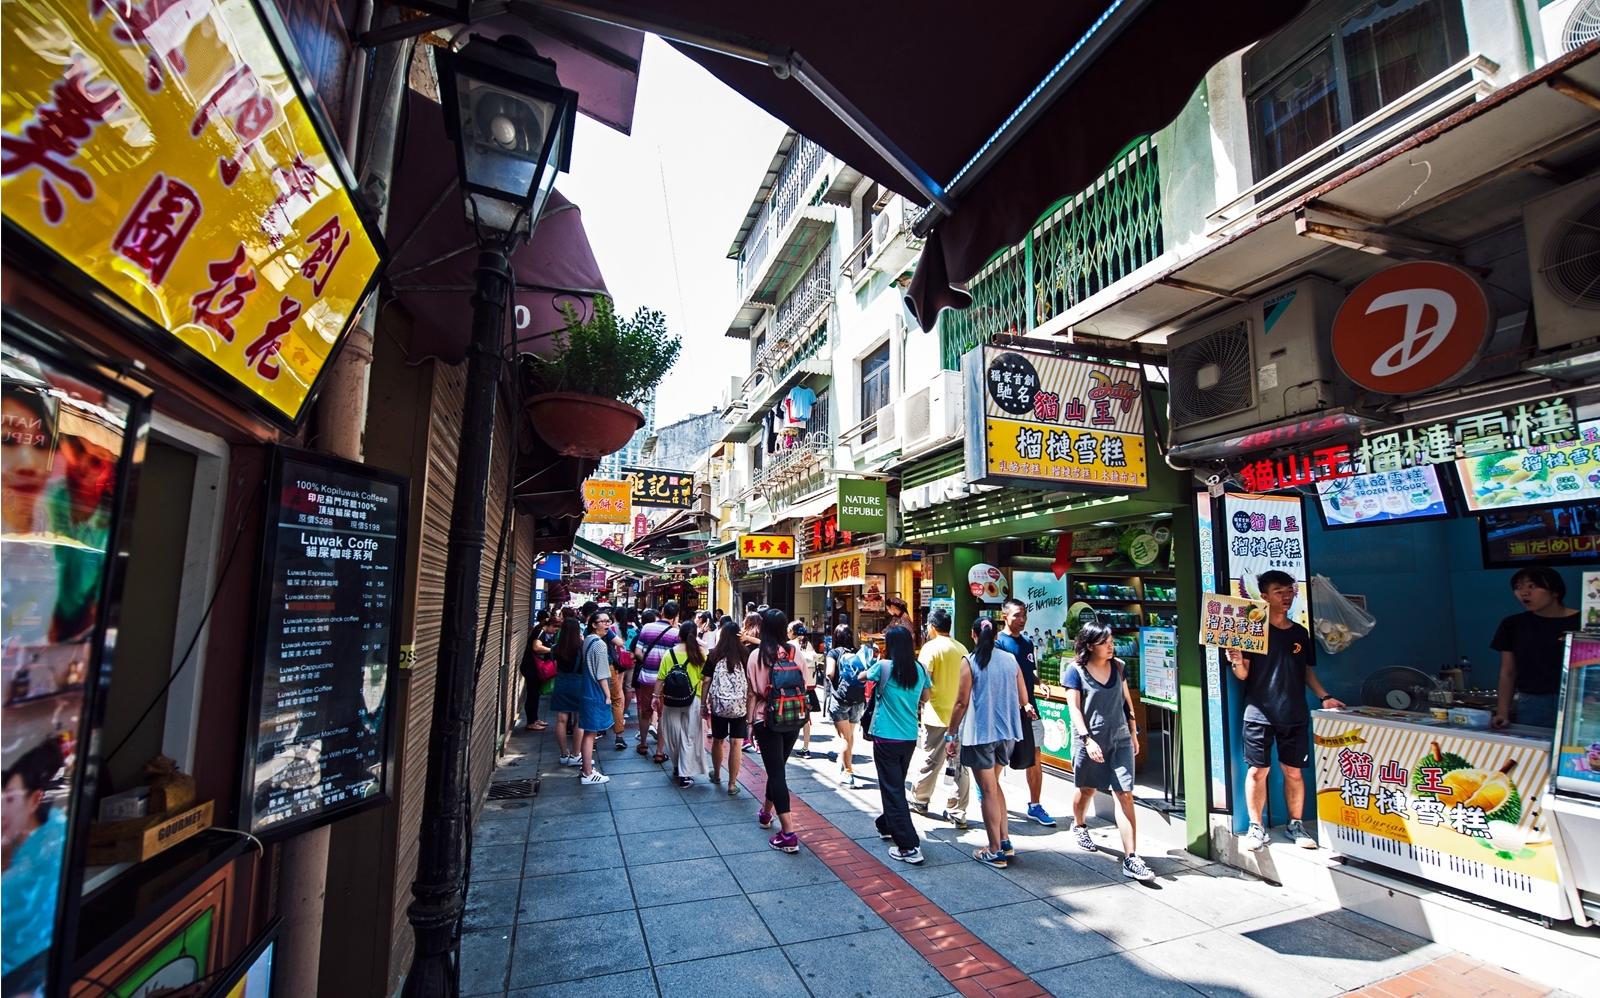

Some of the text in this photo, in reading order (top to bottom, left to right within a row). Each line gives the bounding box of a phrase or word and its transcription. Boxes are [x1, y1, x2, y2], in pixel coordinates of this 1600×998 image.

[990, 369, 1035, 387] 獨家首創
[996, 382, 1031, 404] 馳名
[1033, 390, 1116, 426] 貓山王
[1015, 426, 1128, 468] 榴槤雪糕
[296, 480, 320, 492] 100%
[1356, 481, 1428, 497] FROZEN YOGURT
[845, 494, 880, 505] NATURE
[842, 506, 884, 517] REPUBLIC
[1250, 512, 1300, 532] 貓山王
[301, 532, 378, 551] Luwak Coffe
[1232, 536, 1302, 558] 榴槤雪糕
[305, 545, 373, 562] 貓屎咖啡系列
[307, 570, 334, 578] Espresso
[1027, 586, 1048, 600] FEEL
[1036, 596, 1064, 611] NATURE
[1206, 615, 1265, 637] 榴槤雪糕
[301, 662, 334, 672] Cappuccino
[1338, 748, 1452, 795] 貓山王
[1340, 780, 1492, 839] 榴槤雪糕
[158, 809, 203, 842] GOURMET
[1360, 813, 1407, 834] Durian
